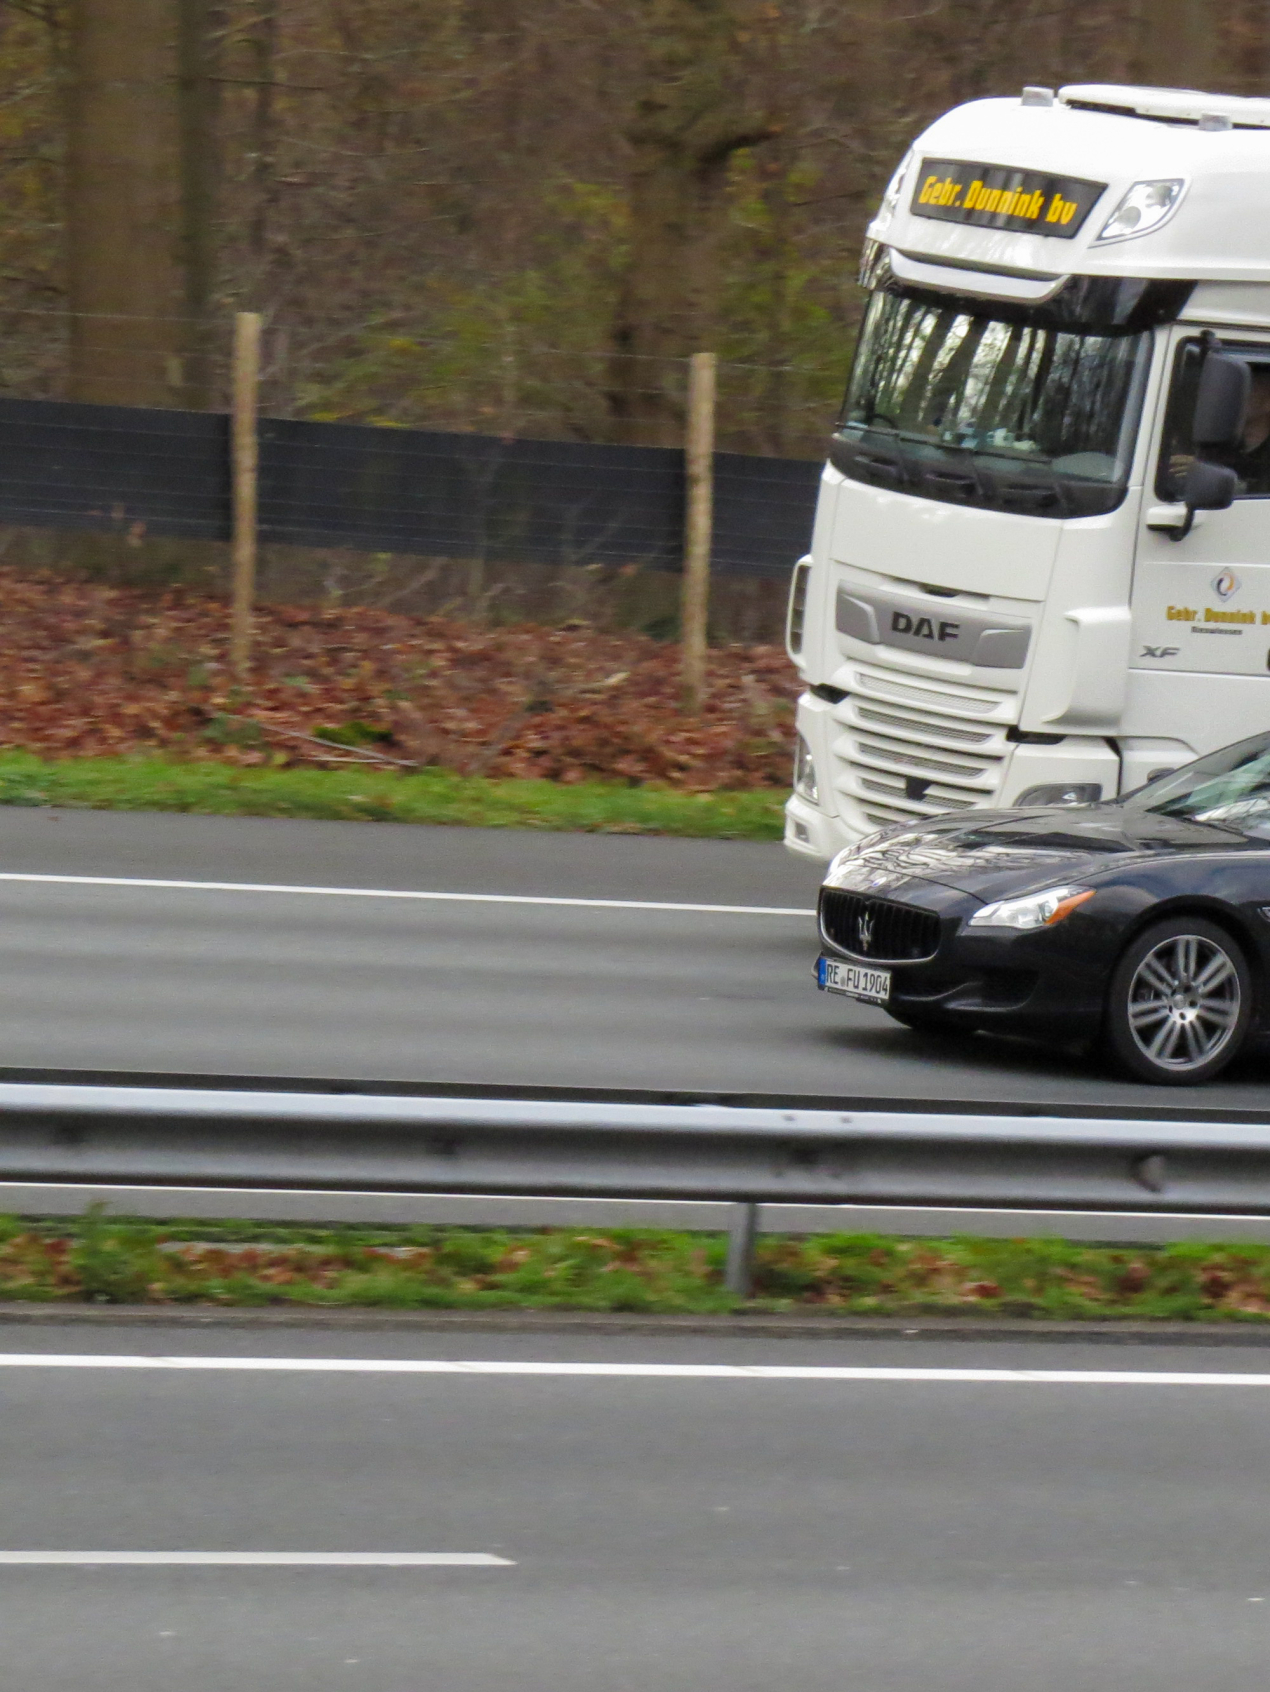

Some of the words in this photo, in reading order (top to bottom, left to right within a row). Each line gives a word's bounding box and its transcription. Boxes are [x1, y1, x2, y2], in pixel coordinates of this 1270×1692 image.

[918, 175, 962, 207] Gebr.
[963, 180, 1045, 219] Dunnink
[1045, 193, 1078, 225] bv
[891, 611, 960, 642] DAF
[1140, 645, 1181, 658] XF
[827, 963, 840, 985] RE
[846, 968, 860, 989] FU
[862, 972, 888, 996] 1904
